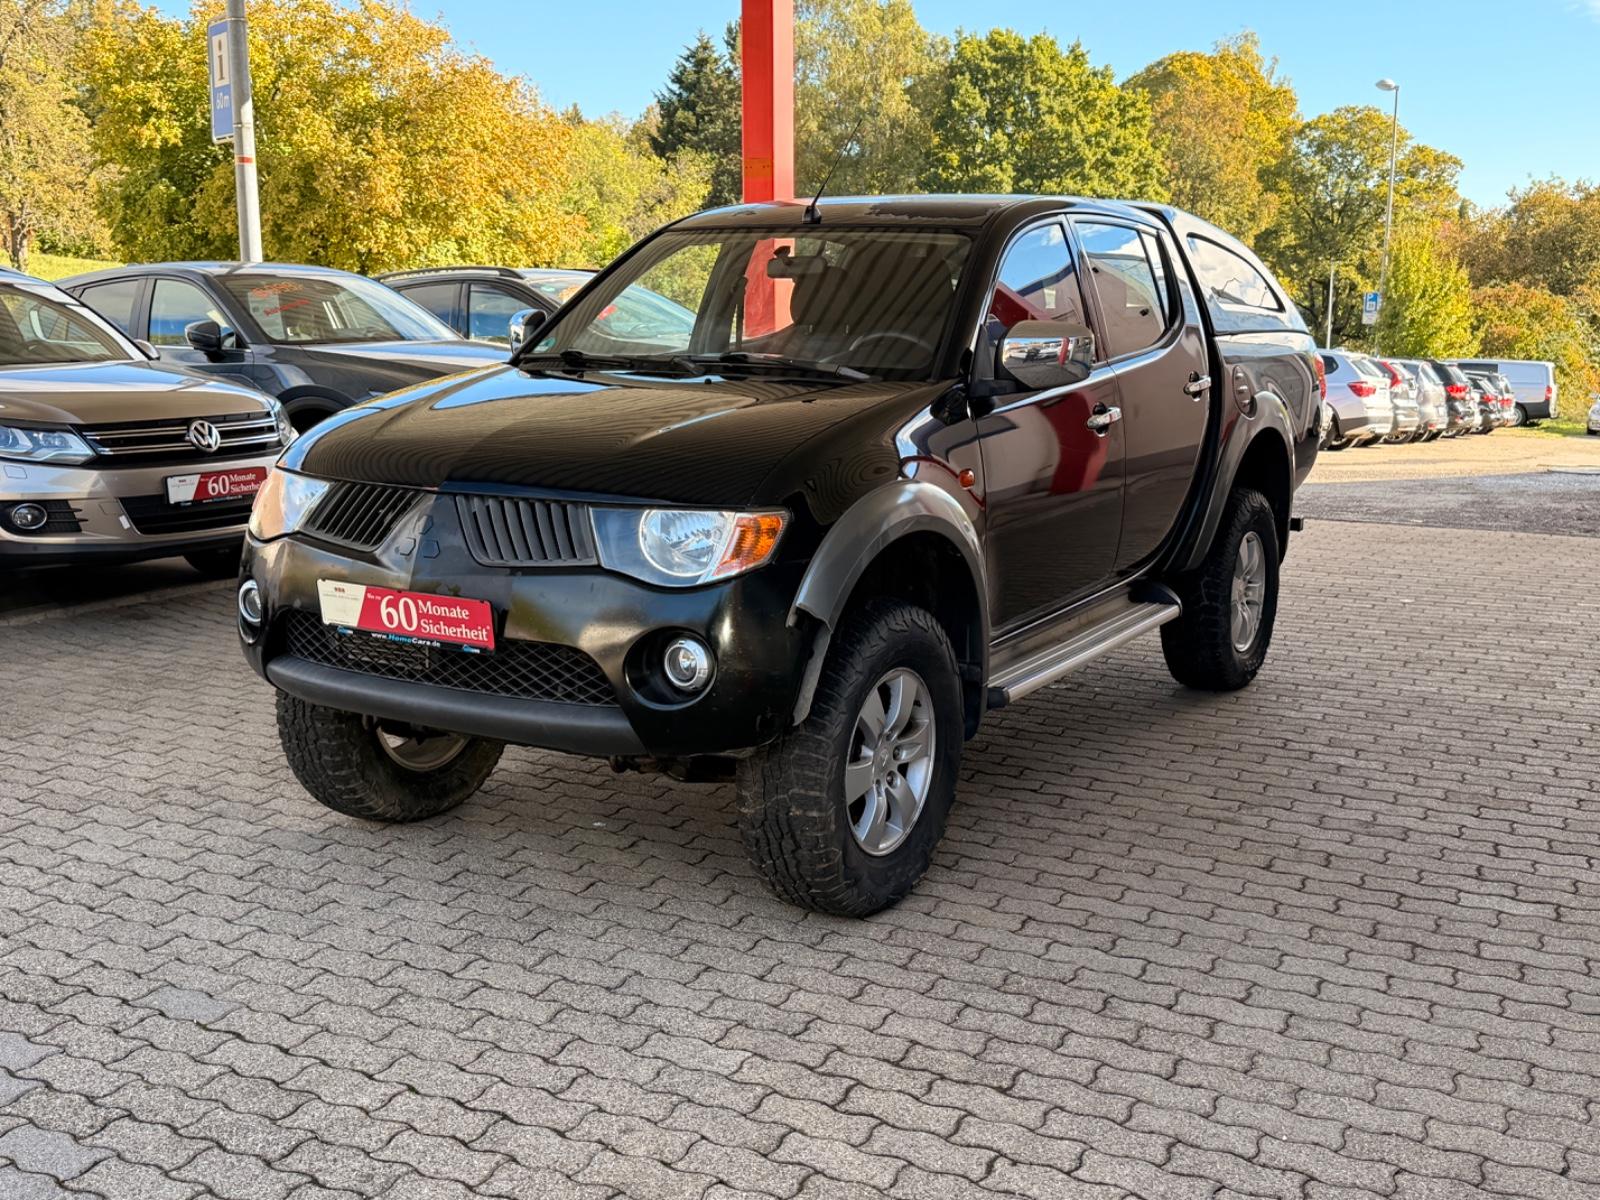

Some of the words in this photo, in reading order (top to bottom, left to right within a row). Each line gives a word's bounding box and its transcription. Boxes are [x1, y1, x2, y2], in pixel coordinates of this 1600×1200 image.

[208, 475, 230, 495] 60
[230, 473, 256, 482] Monate
[380, 595, 418, 631] 60
[418, 599, 470, 620] Monate
